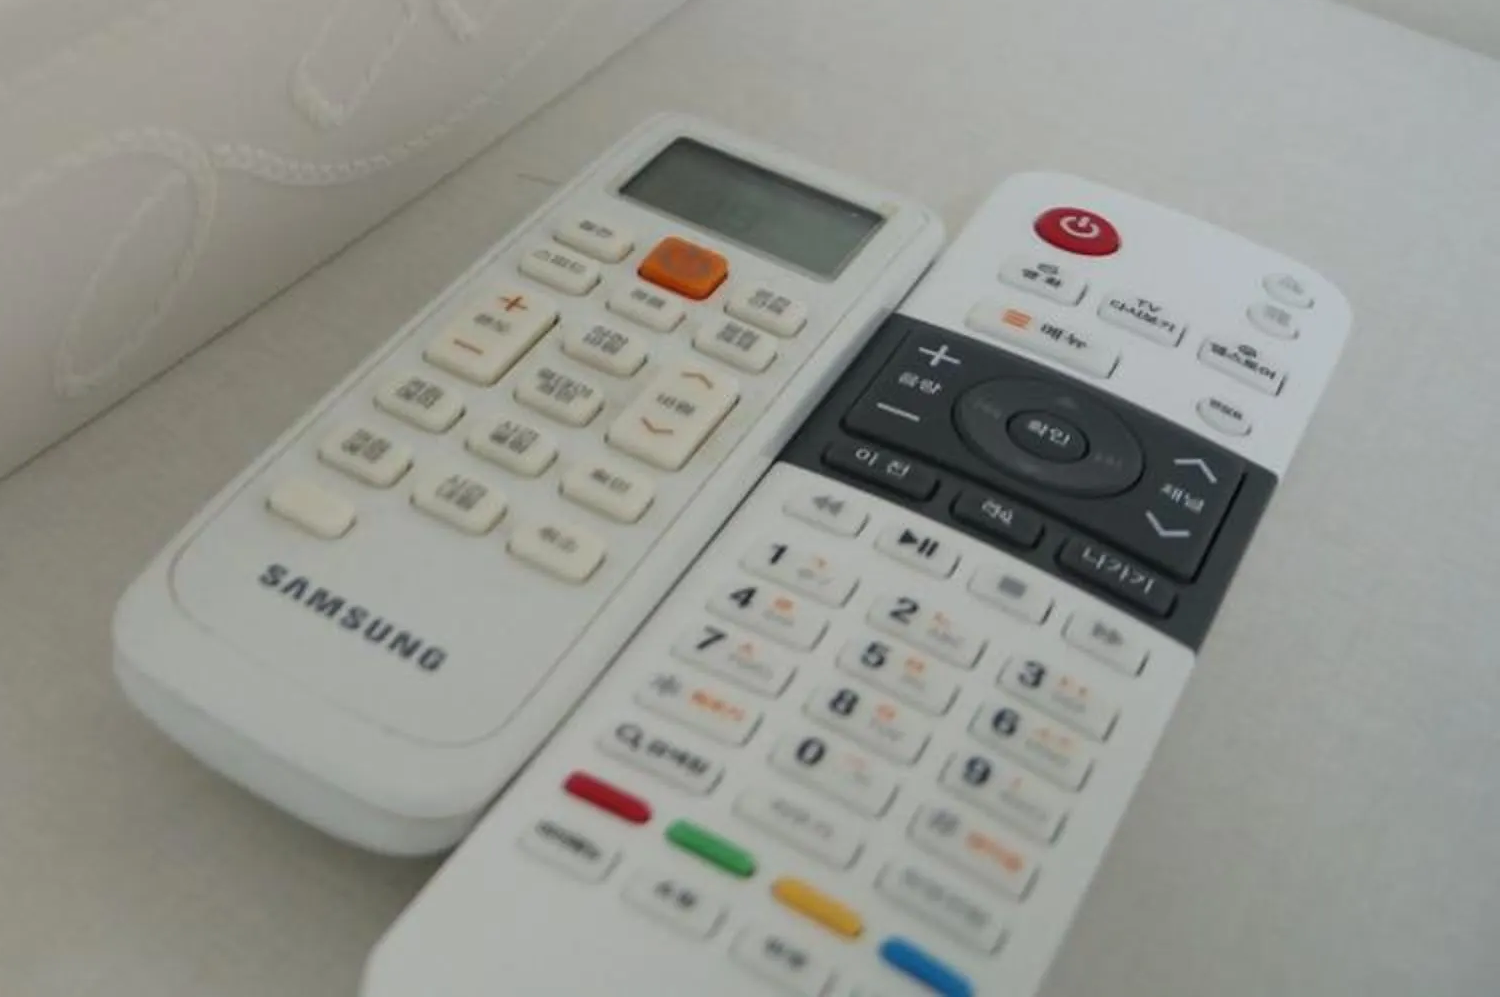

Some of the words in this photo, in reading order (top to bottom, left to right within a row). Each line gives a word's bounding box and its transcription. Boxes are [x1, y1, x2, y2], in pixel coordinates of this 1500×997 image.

[1040, 323, 1087, 349] 메뉴
[1028, 420, 1071, 446] 확인
[770, 544, 787, 564] 1
[1083, 546, 1156, 594] 나가기
[730, 586, 757, 608] 4
[890, 597, 918, 623] 2
[259, 563, 448, 672] SAMSUNG
[697, 626, 726, 650] 7
[861, 642, 890, 668] 5
[1018, 661, 1046, 688] 3
[830, 689, 859, 716] 8
[992, 708, 1020, 736] 6
[796, 738, 825, 766] 0
[964, 756, 992, 786] 9
